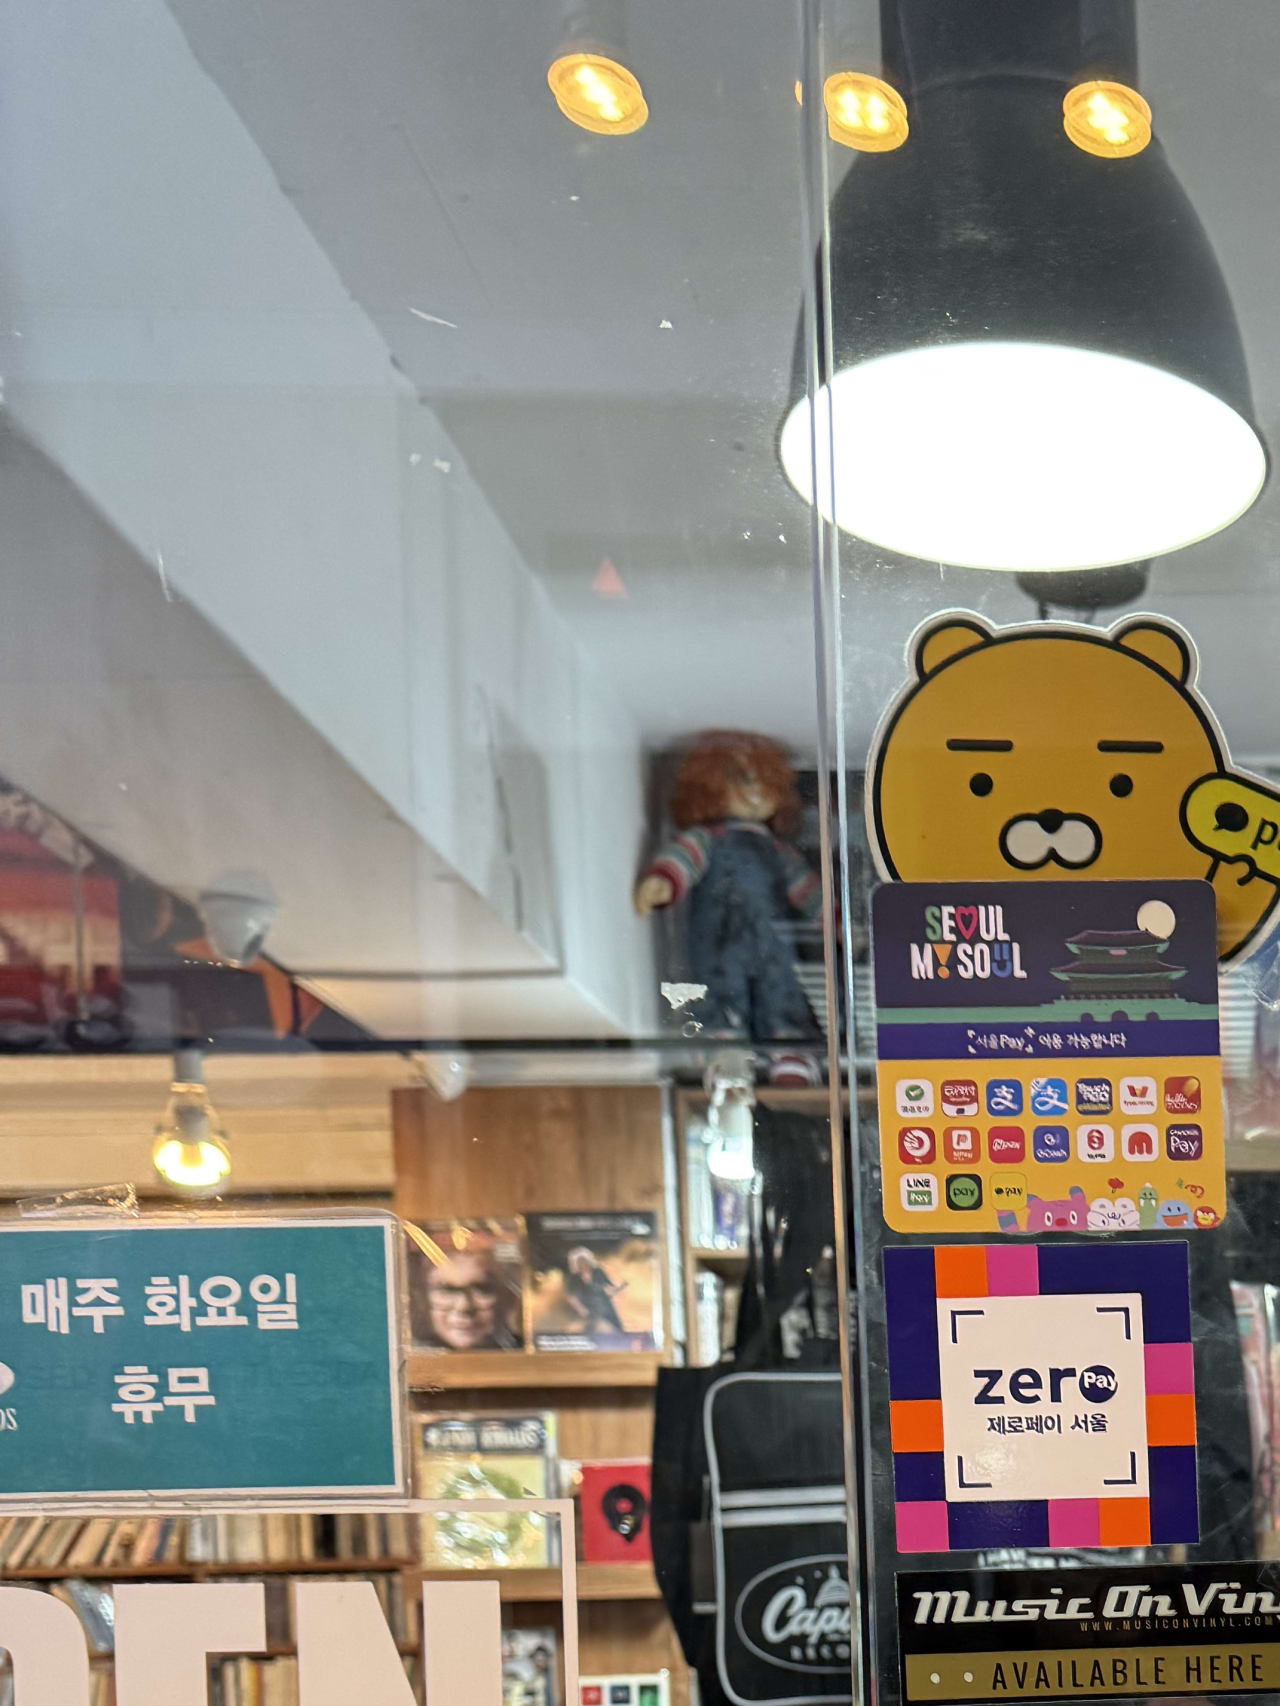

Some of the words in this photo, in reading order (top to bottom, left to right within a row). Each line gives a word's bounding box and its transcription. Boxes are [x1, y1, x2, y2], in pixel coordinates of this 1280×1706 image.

[22, 1277, 125, 1334] 매주
[144, 1273, 299, 1331] 화요일
[111, 1365, 216, 1424] 휴무
[987, 1414, 1062, 1435] 제로페이
[1070, 1412, 1109, 1434] 서울
[912, 1588, 1095, 1624] Music
[1102, 1584, 1178, 1618] On
[992, 1657, 1167, 1690] AVAILABLE
[1185, 1653, 1264, 1684] HERE
